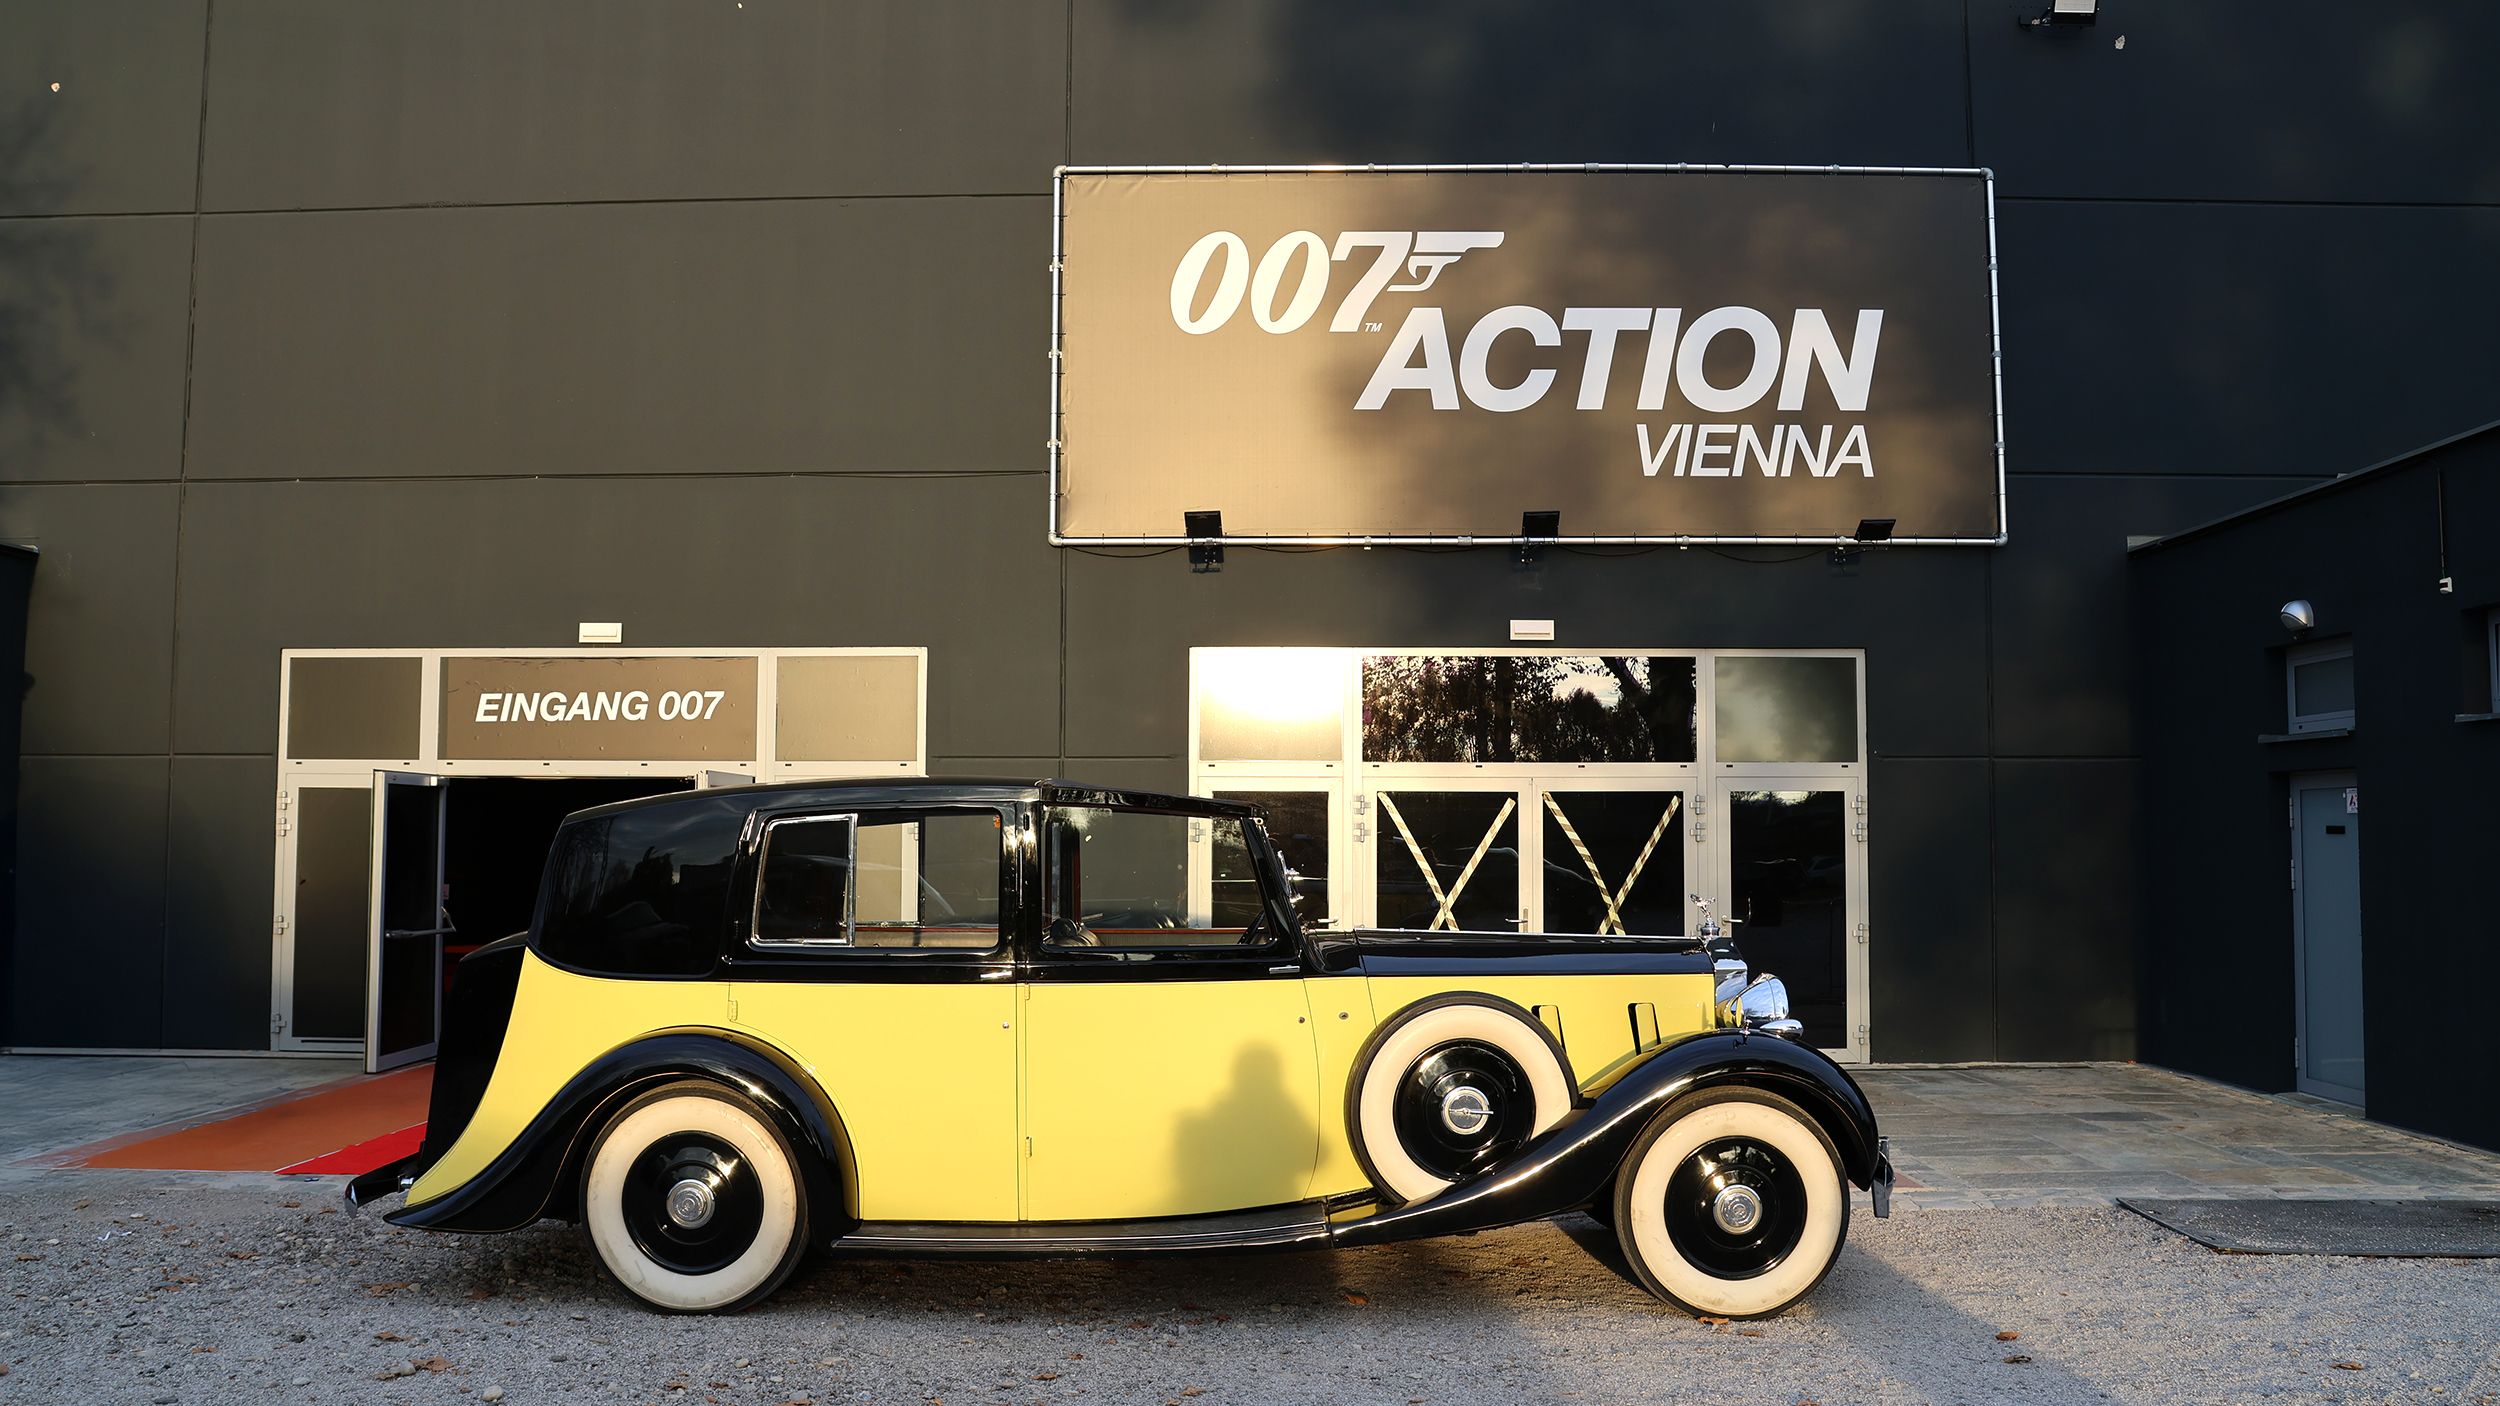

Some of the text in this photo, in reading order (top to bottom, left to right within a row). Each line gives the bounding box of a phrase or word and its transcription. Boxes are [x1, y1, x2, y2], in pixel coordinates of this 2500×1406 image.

[1169, 230, 1414, 335] 007 TM
[1352, 305, 1884, 413] ACTION
[1636, 423, 1876, 478] VIENNA
[475, 690, 726, 723] EINGANG 007
